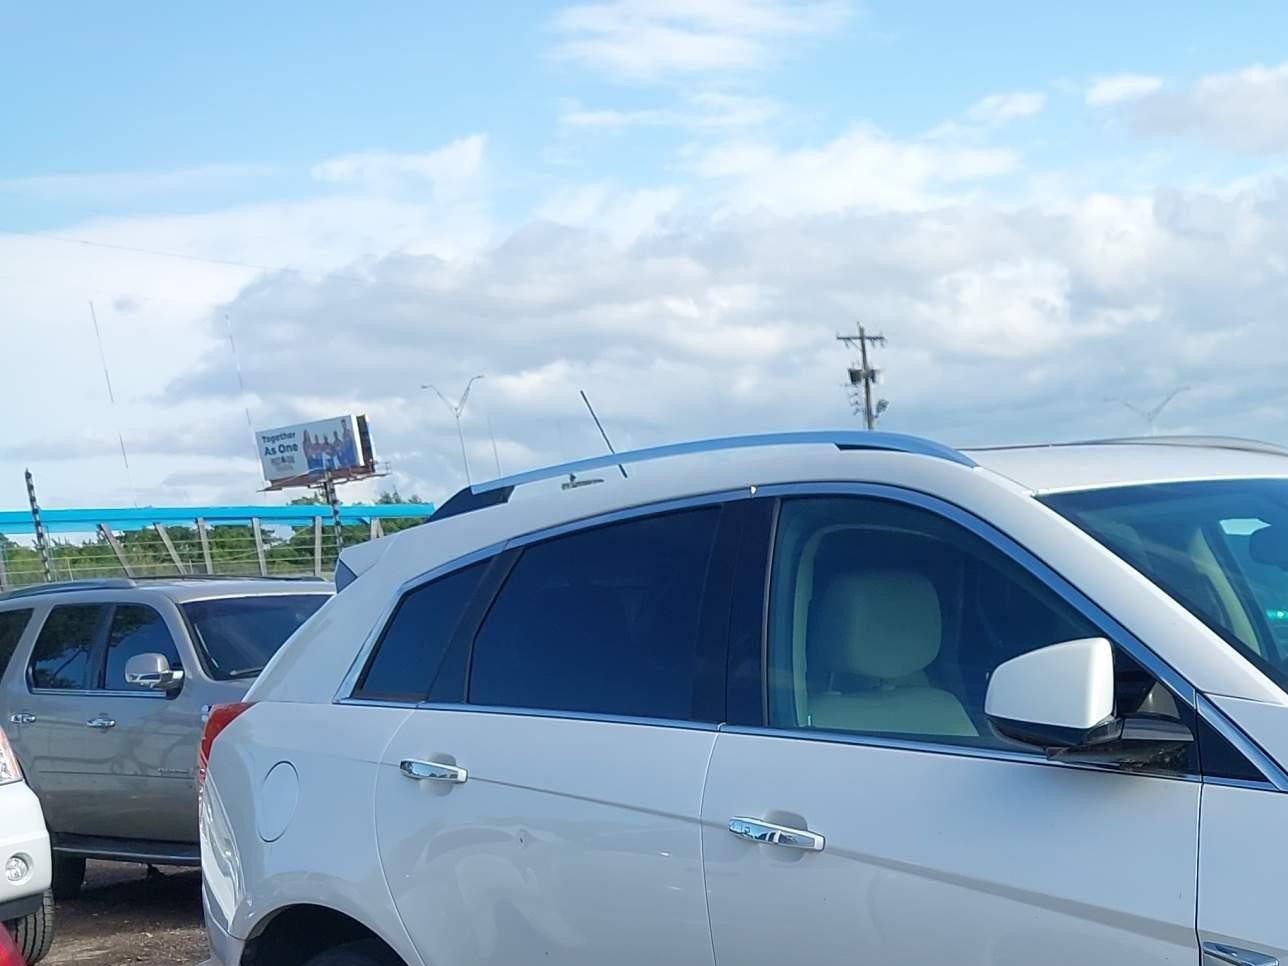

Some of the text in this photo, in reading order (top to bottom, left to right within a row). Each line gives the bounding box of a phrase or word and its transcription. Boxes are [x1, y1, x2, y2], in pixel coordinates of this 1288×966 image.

[262, 431, 296, 443] Together
[264, 443, 298, 456] As One
